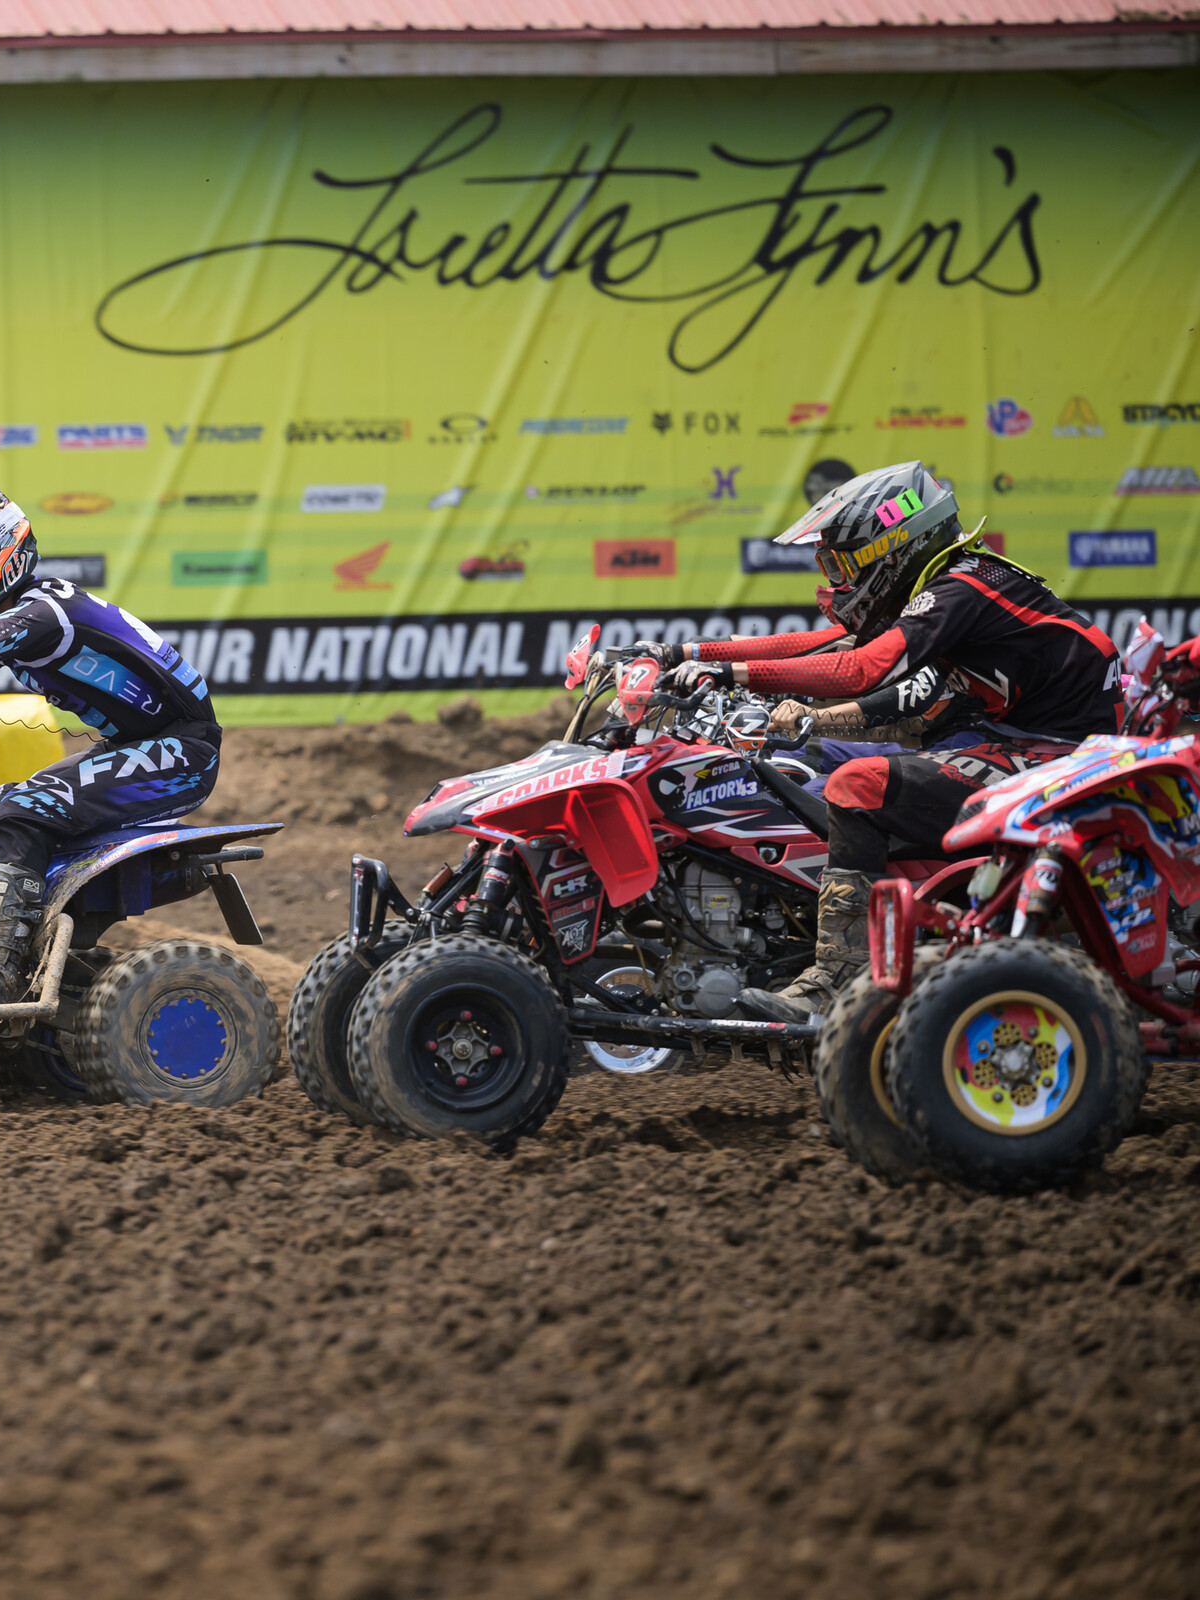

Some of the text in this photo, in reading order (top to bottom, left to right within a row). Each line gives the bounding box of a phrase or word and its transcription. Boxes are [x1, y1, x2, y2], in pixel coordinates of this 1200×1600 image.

[96, 103, 698, 357] Loretta
[683, 411, 741, 435] FOX
[853, 526, 909, 568] 100%
[264, 622, 529, 684] NATIONAL
[78, 736, 191, 788] FXR
[711, 761, 741, 777] CYCRA
